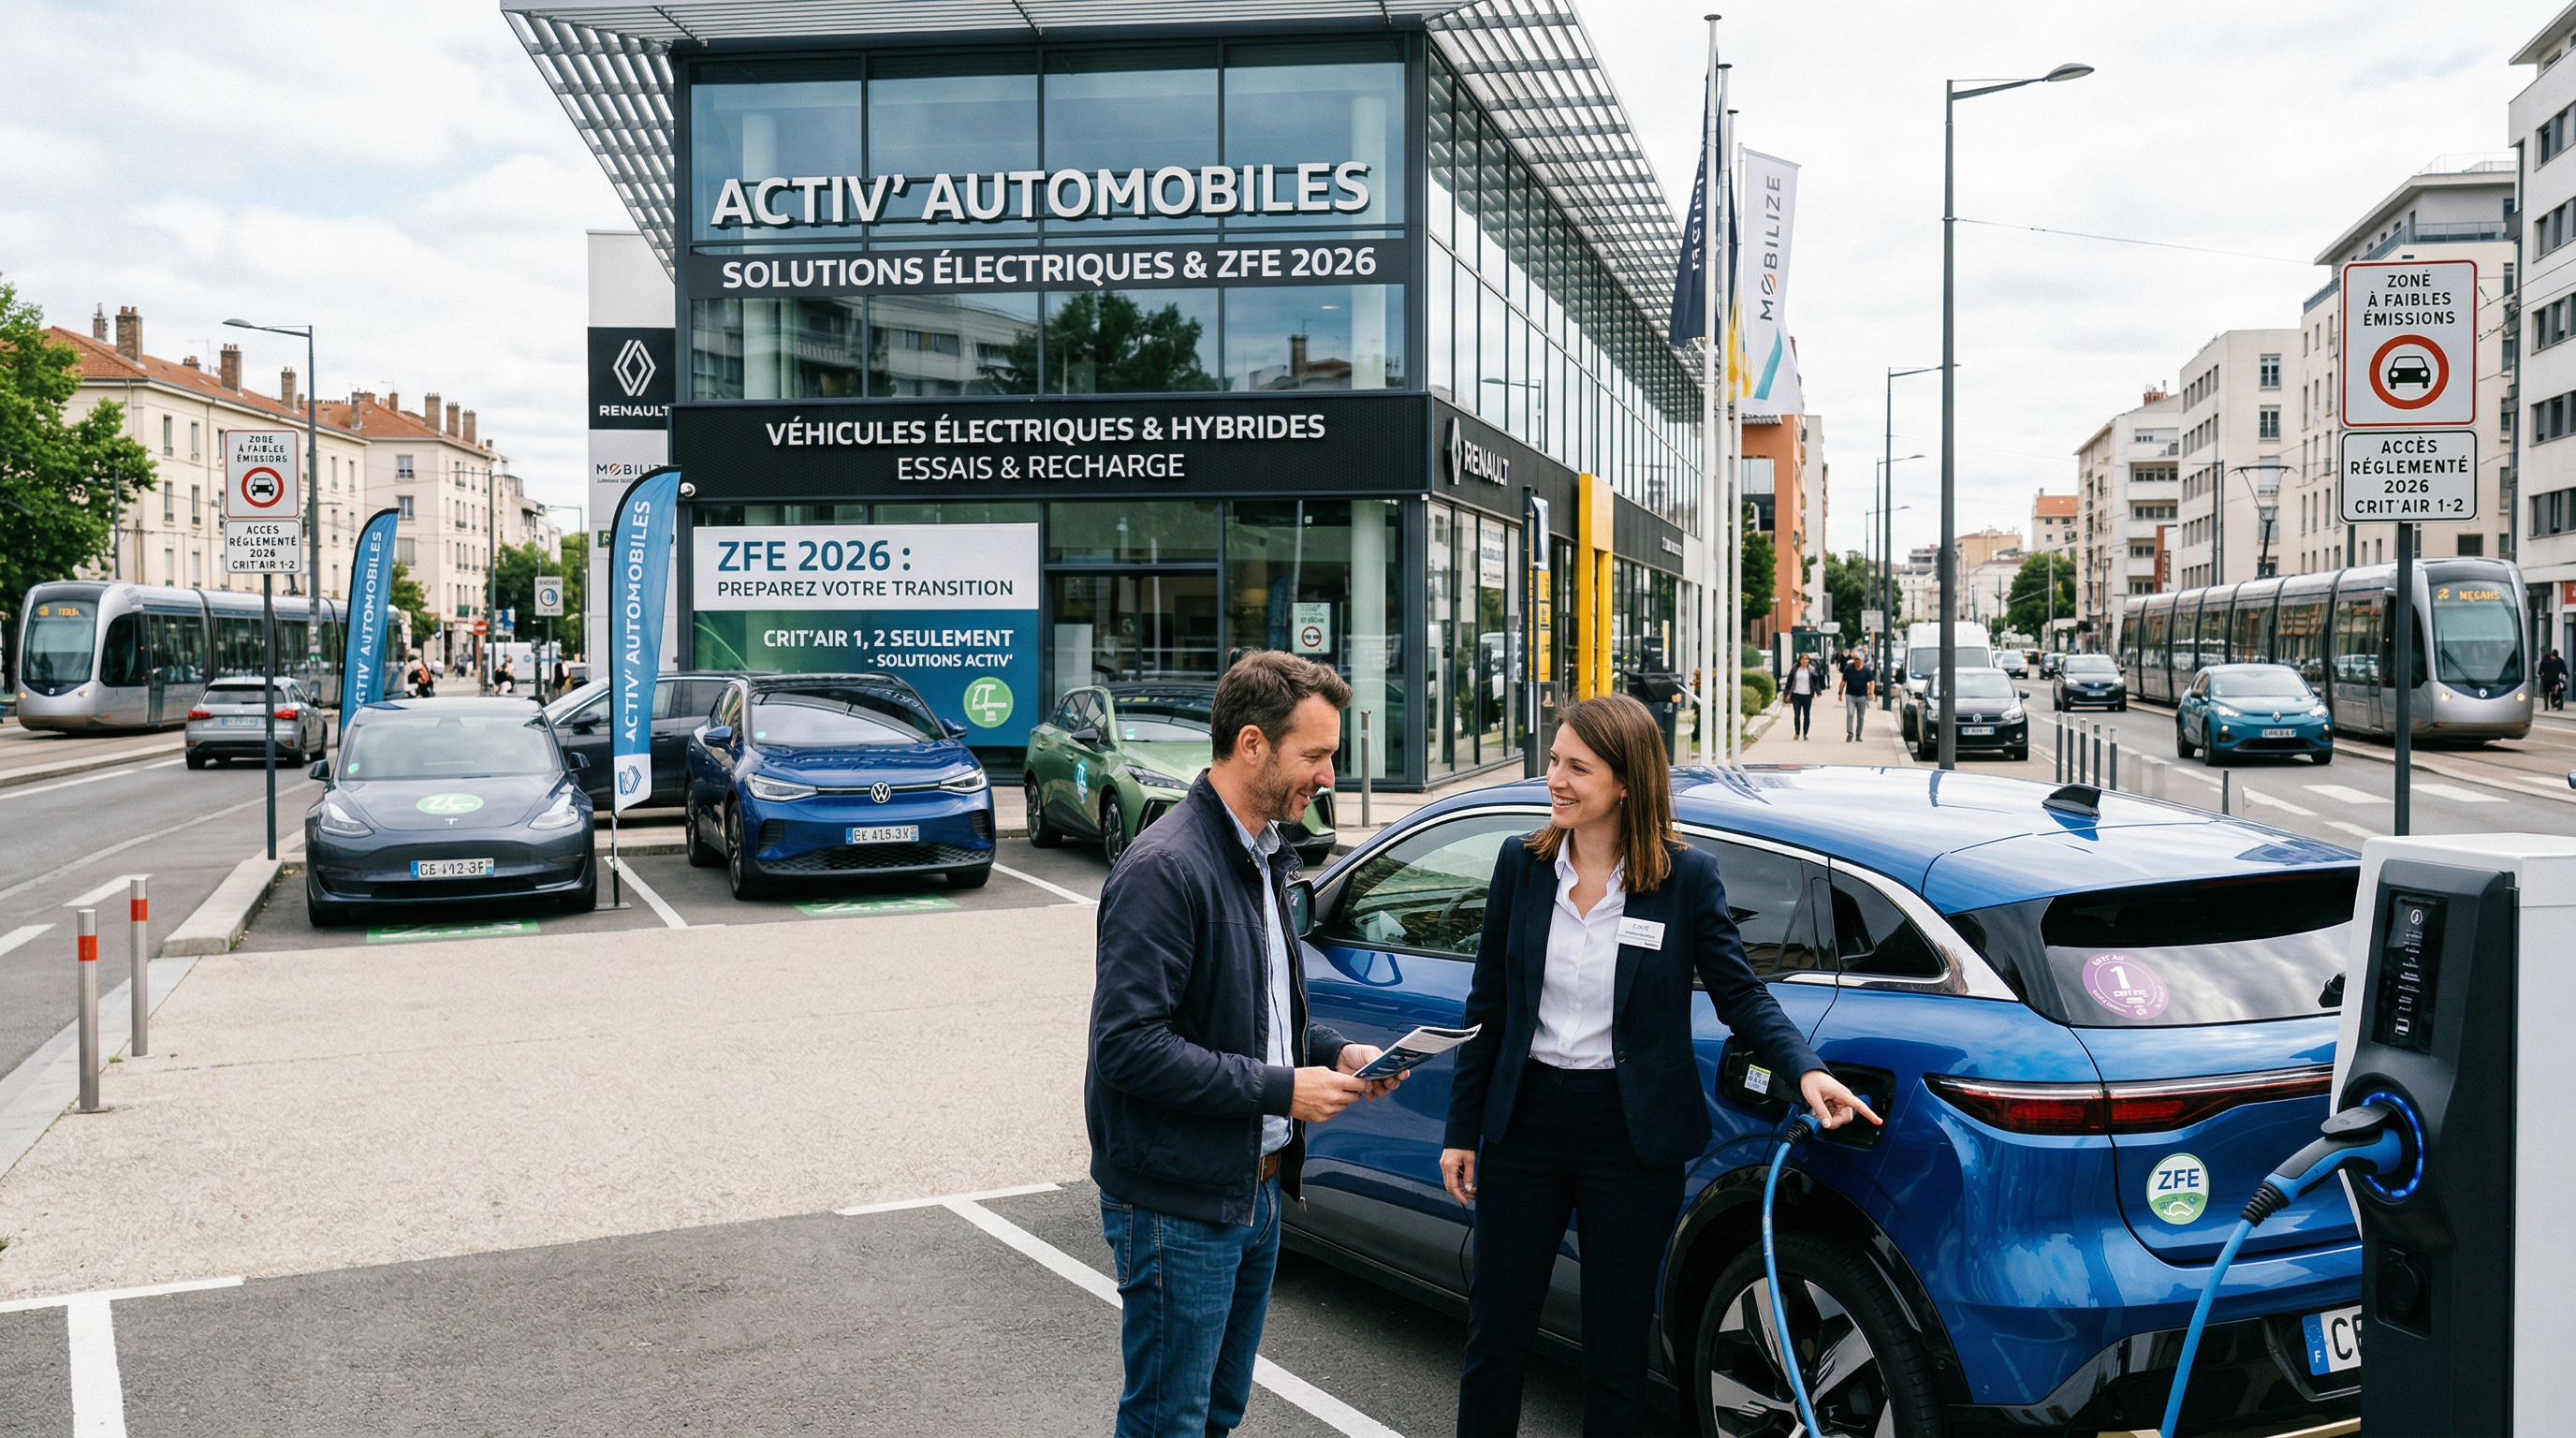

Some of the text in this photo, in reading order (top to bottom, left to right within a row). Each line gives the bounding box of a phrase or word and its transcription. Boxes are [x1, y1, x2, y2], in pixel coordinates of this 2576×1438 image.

[710, 161, 1371, 226] ACTIV' AUTOMOBILES
[722, 247, 1377, 289] SOLUTIONS ÉLECTRIQUES & ZFE 2026
[2367, 290, 2452, 308] À FAIBLES
[2363, 309, 2456, 327] ÉMISSIONS
[598, 404, 670, 417] RENAULT
[765, 413, 1326, 447] VÉHICULES ÉLECTRIQUES & HYBRIDES
[2380, 435, 2438, 454] ACCÈS
[897, 453, 1186, 481] ESSAIS & RECHARGE
[1464, 439, 1510, 487] RENAULT
[2349, 454, 2468, 475] RÉGLEMENTÉ
[2383, 478, 2430, 494] 2026
[2354, 497, 2465, 514] CRIT'AIR 1-2
[249, 549, 277, 558] 2026
[717, 540, 912, 572] ZFE 2026 :
[625, 499, 651, 666] AUTOMOBILES
[717, 580, 1015, 596] PREPAREZ VOTRE TRANSITION
[359, 531, 382, 656] AUTOMOBILES
[763, 629, 1015, 651] CRIT'AIR 1, 2 SEULEMENT
[876, 653, 962, 668] SOLUTIONS
[2158, 1167, 2201, 1190] ZFE
[2314, 1349, 2321, 1364] F
